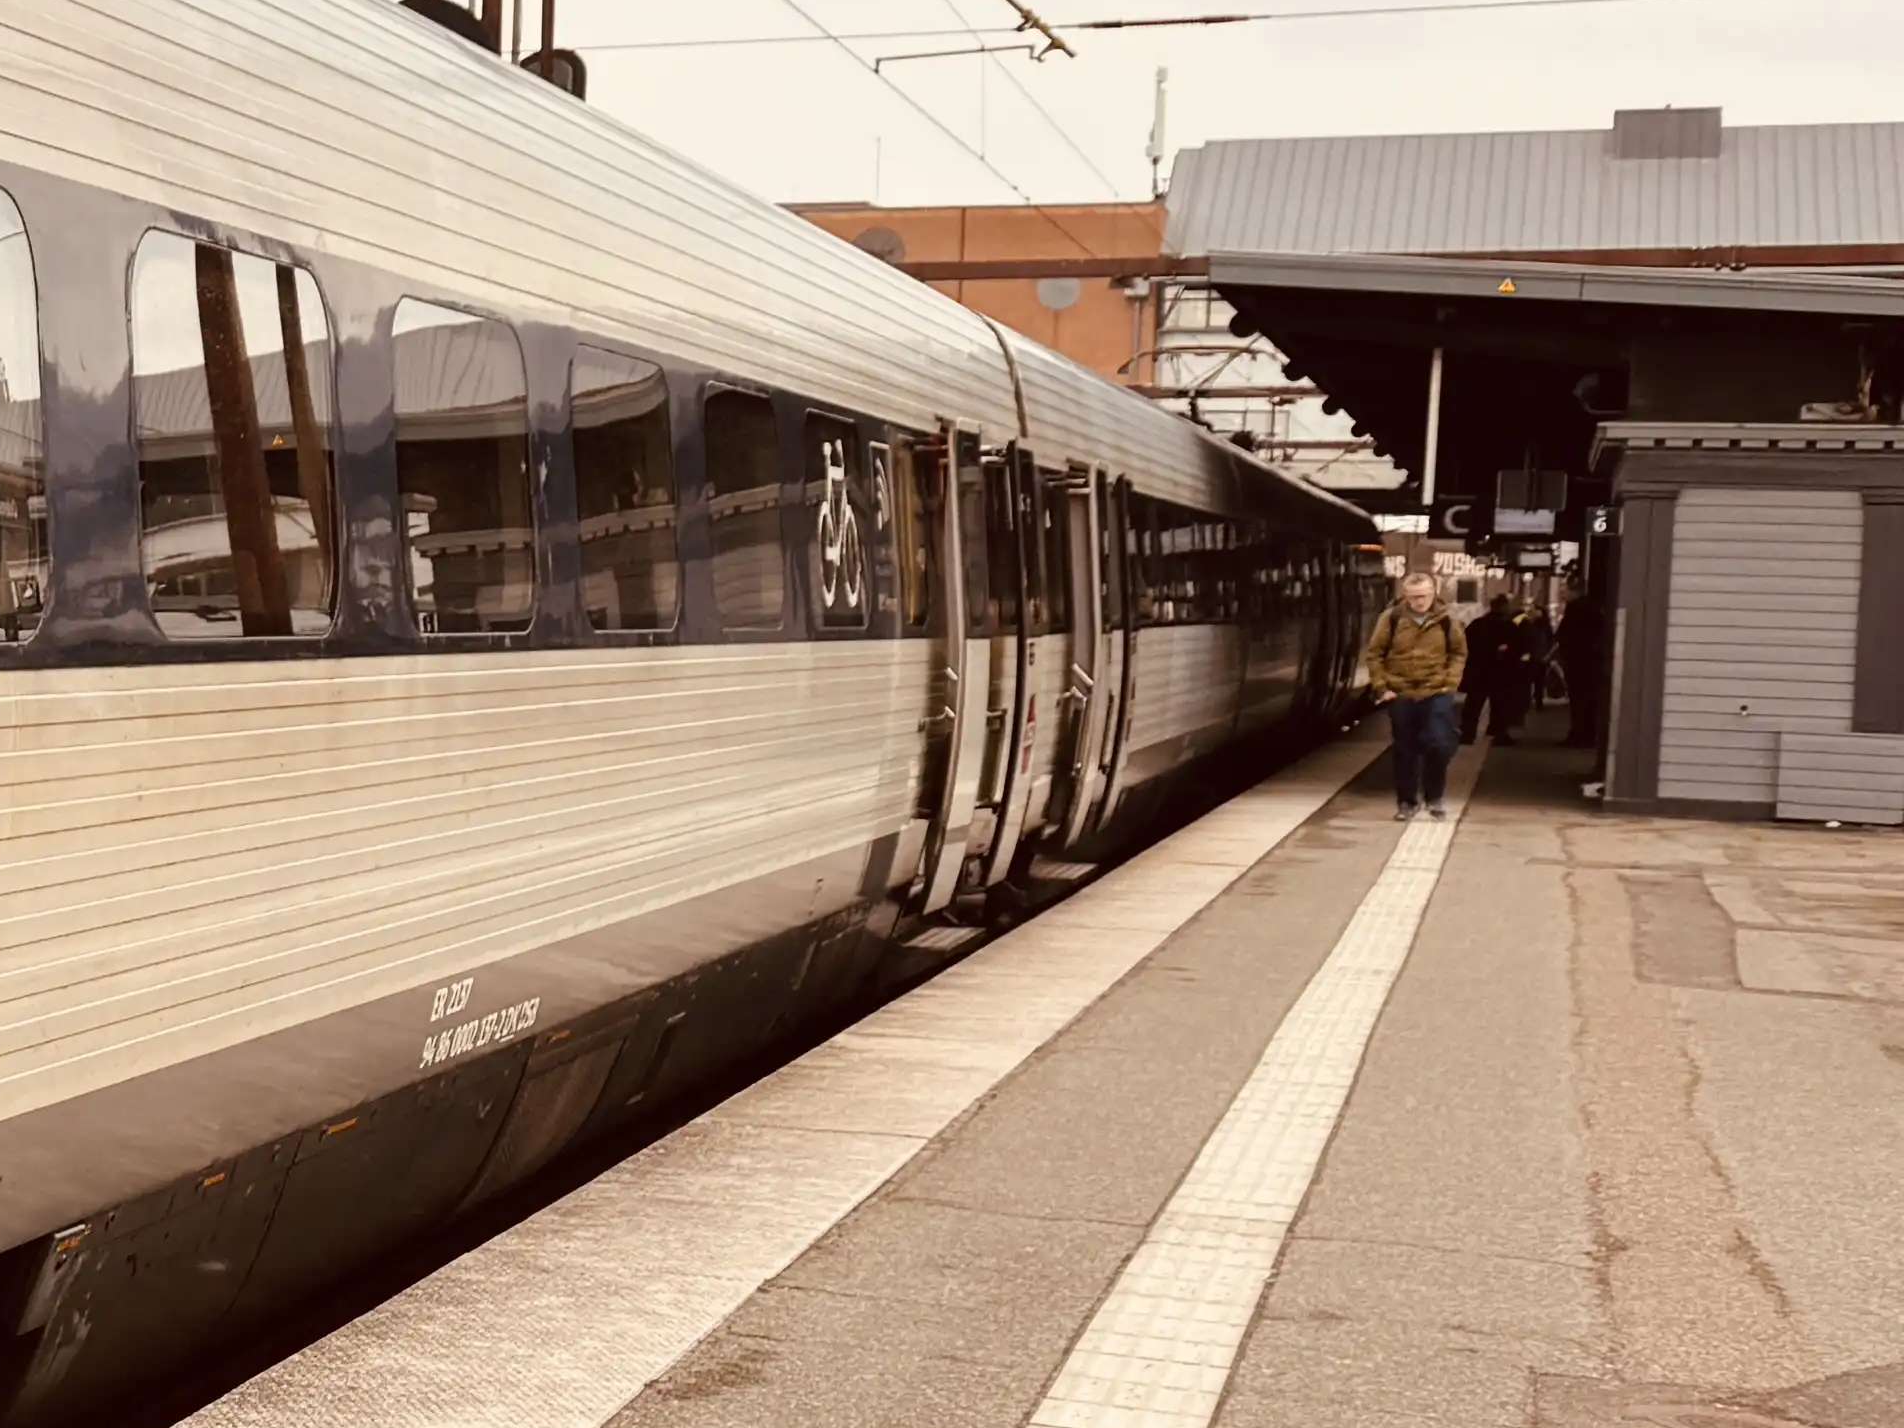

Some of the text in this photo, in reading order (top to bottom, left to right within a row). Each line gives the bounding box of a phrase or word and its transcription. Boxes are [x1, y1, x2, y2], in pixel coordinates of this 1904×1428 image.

[1593, 516, 1607, 533] 6
[430, 977, 474, 1022] ER 2137
[419, 1035, 438, 1069] 94
[434, 1028, 454, 1064] 86
